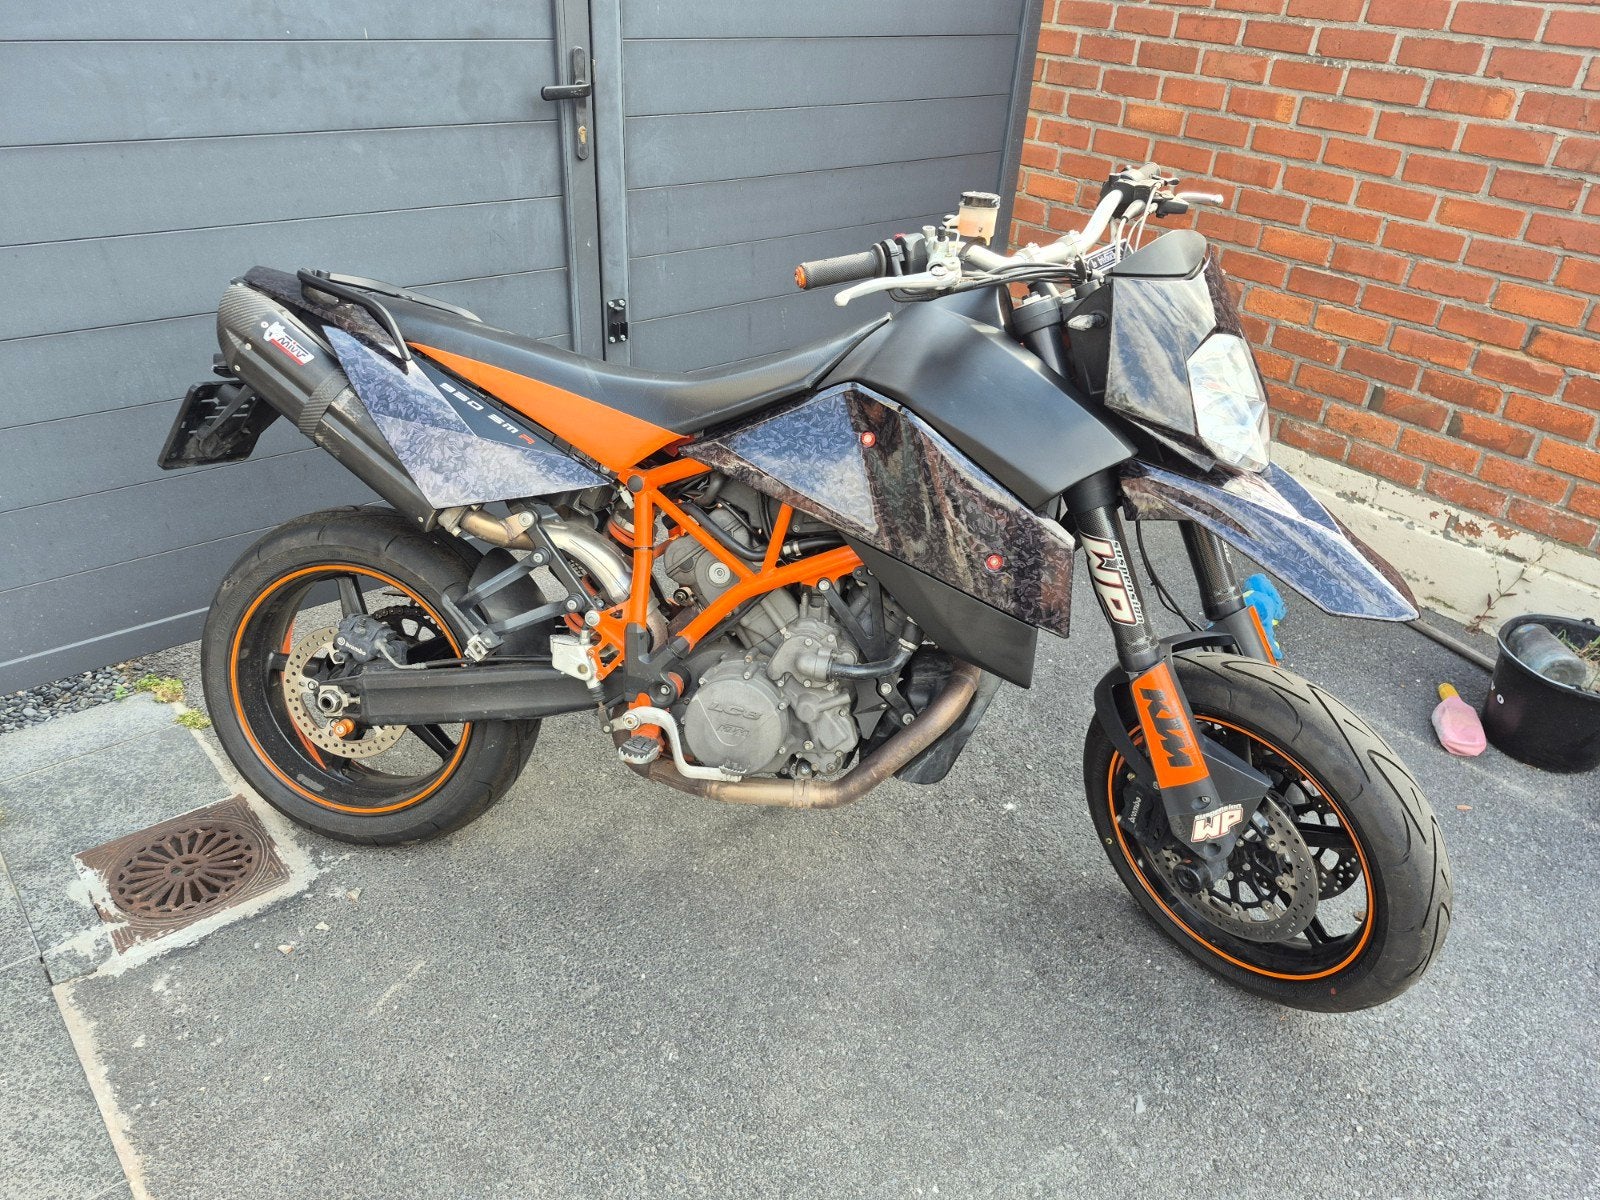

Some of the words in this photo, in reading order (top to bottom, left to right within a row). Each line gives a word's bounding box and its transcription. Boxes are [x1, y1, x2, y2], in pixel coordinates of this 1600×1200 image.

[1080, 533, 1137, 626] WP
[1113, 541, 1144, 623] suspension
[345, 641, 367, 656] brembo
[1140, 688, 1195, 767] KTM
[1191, 808, 1243, 842] WP
